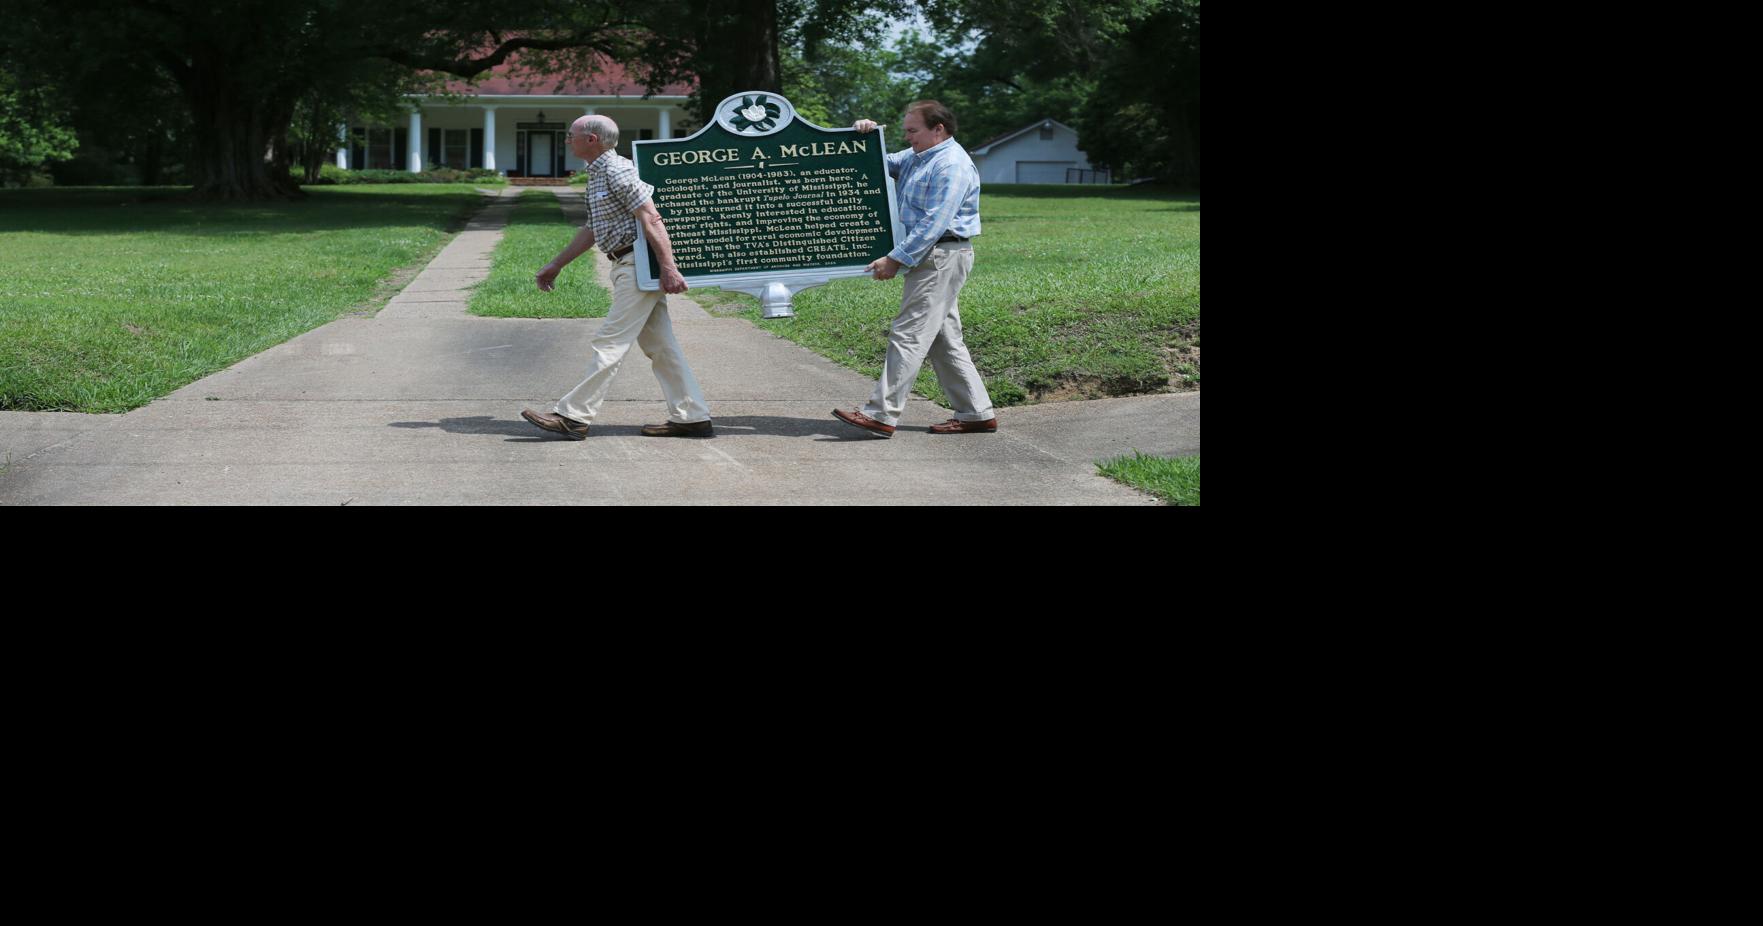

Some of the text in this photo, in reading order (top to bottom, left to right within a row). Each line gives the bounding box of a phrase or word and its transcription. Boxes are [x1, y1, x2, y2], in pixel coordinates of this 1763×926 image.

[653, 148, 740, 166] GEORGE
[780, 140, 867, 158] McLEAN
[701, 175, 735, 183] McLean
[654, 200, 696, 208] urchased
[717, 195, 760, 205] bankrupt
[793, 191, 824, 199] Journal
[659, 192, 702, 201] graduate
[736, 187, 785, 196] University
[685, 206, 706, 214] 1936
[710, 204, 742, 212] turned
[786, 199, 834, 208] successful
[720, 212, 752, 220] Keenly
[756, 208, 805, 217] interested
[808, 206, 818, 214] in
[665, 223, 698, 231] orkers'
[756, 217, 803, 225] improving
[766, 224, 802, 232] McLean
[804, 221, 836, 230] helped
[779, 230, 822, 239] economic
[671, 246, 702, 254] arning
[772, 237, 837, 248] Distinguished
[840, 235, 876, 243] Citizen
[749, 247, 804, 256] established
[736, 257, 758, 265] first
[760, 255, 812, 264] community
